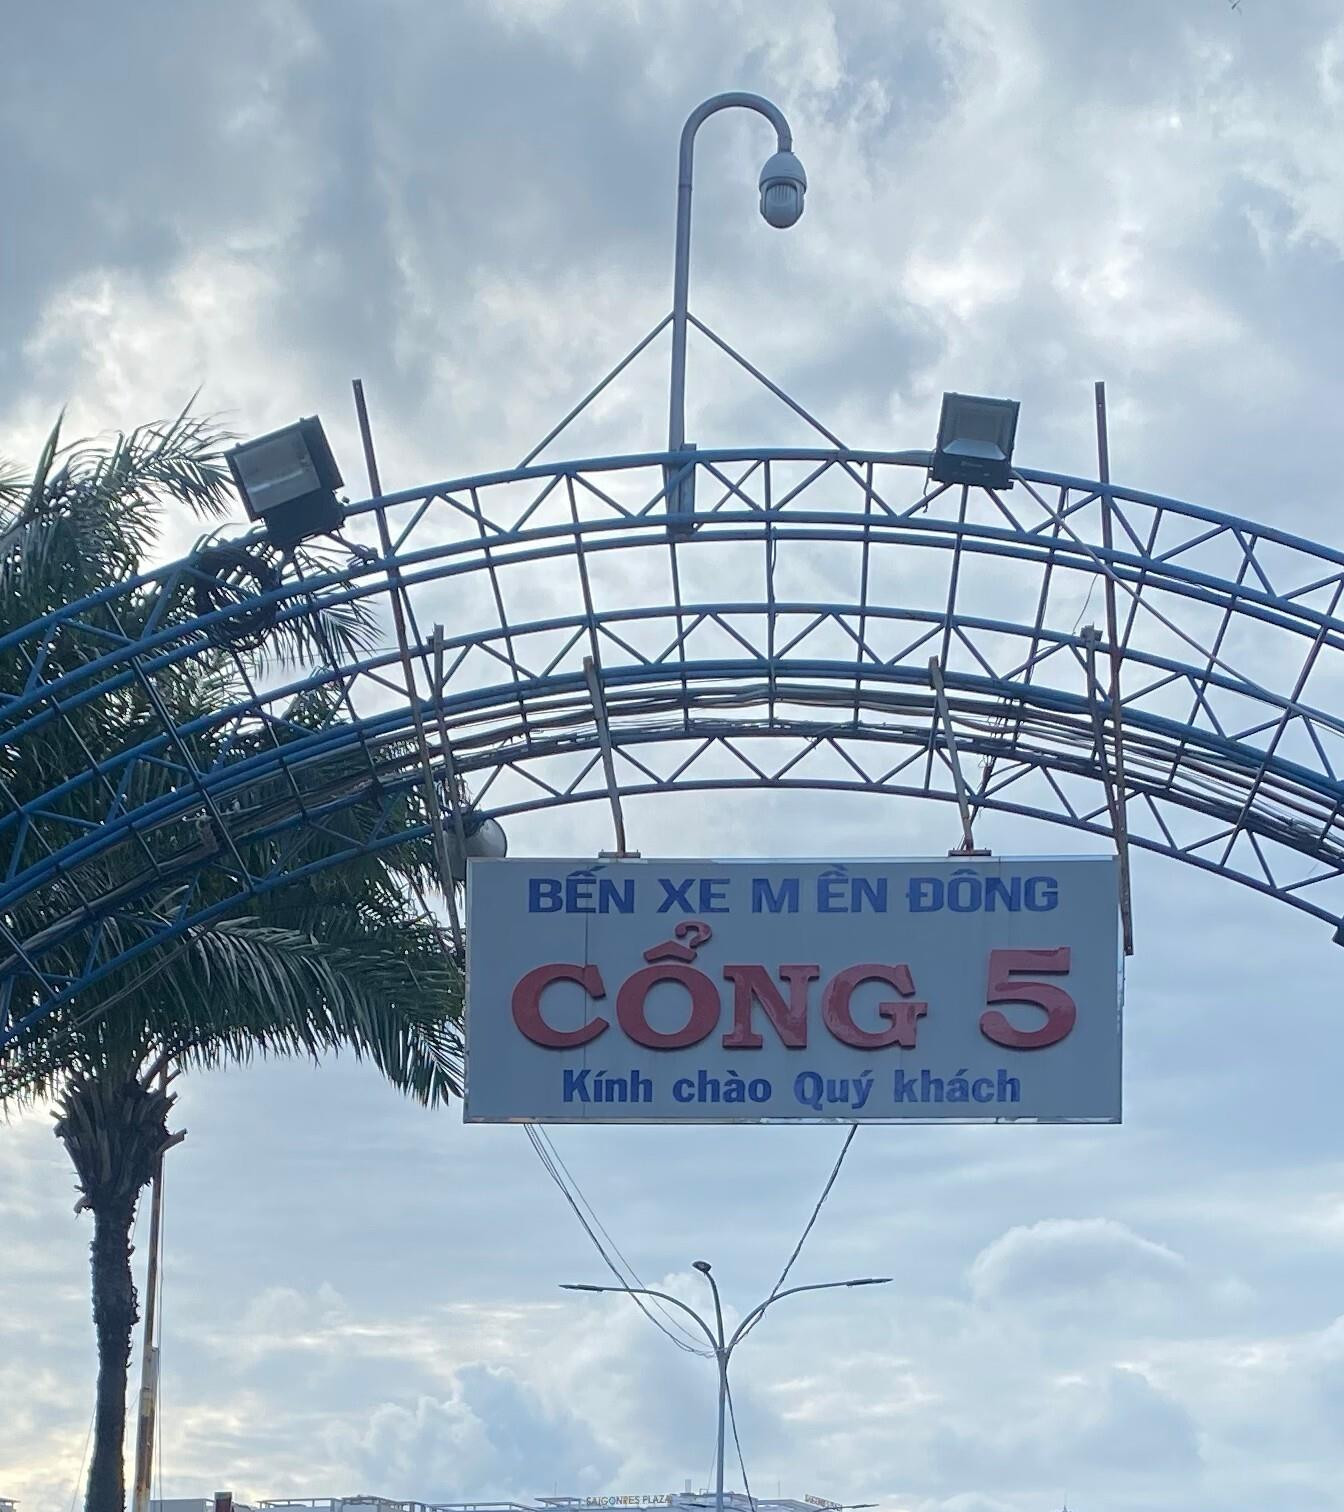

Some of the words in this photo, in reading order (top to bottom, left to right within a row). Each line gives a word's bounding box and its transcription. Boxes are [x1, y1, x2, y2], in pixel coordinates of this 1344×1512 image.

[527, 866, 636, 914] BẾN
[656, 877, 731, 914] XE
[905, 868, 1059, 914] ĐÔNG
[511, 921, 928, 1051] CỔNG
[978, 946, 1077, 1052] 5
[563, 1069, 653, 1104] Kính
[672, 1069, 772, 1104] chào
[793, 1069, 875, 1110] Quý
[893, 1069, 1022, 1104] khách
